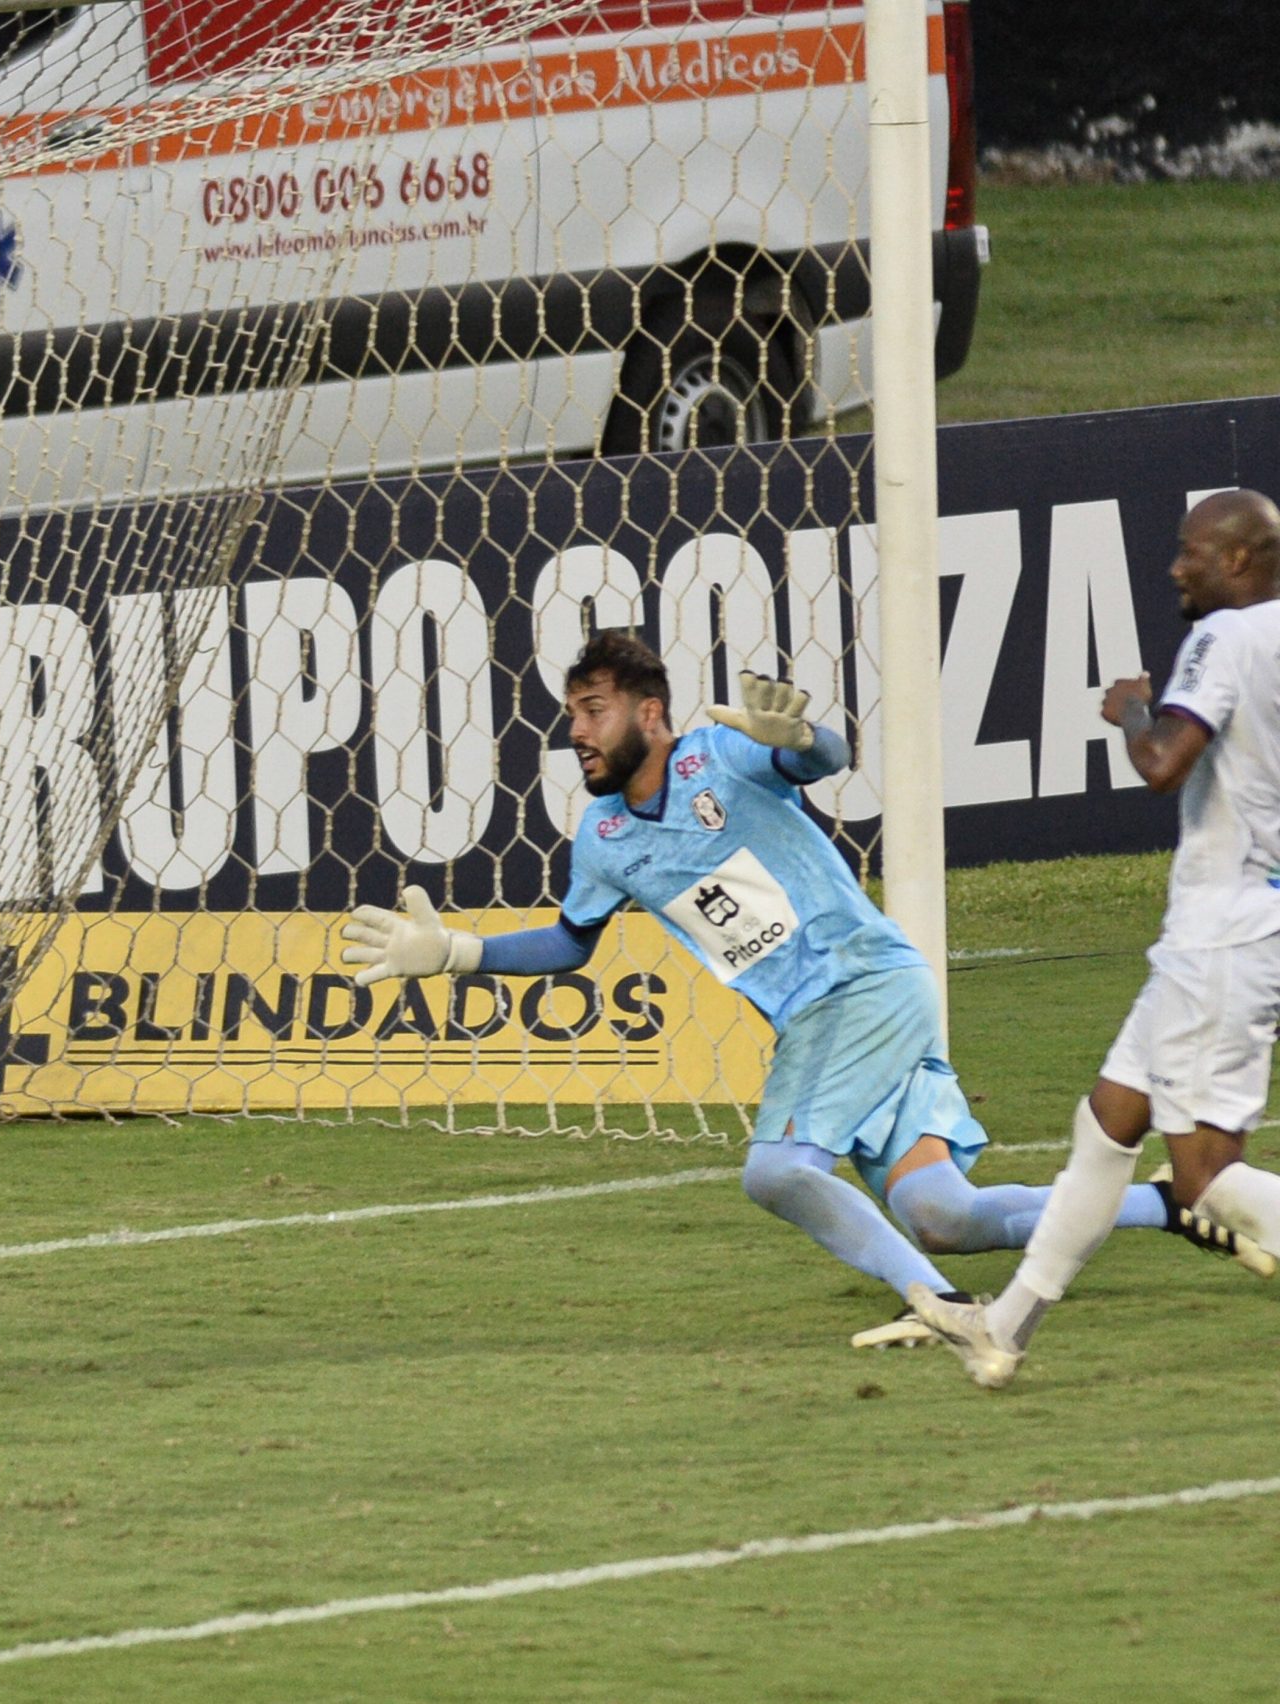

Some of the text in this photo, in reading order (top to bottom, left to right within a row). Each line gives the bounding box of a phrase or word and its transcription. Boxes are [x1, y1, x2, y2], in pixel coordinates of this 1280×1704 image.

[202, 152, 491, 226] 0800 006 6668
[531, 498, 1150, 842] SOUZA
[722, 921, 785, 968] Pitaco
[67, 972, 668, 1042] BLINDADOS
